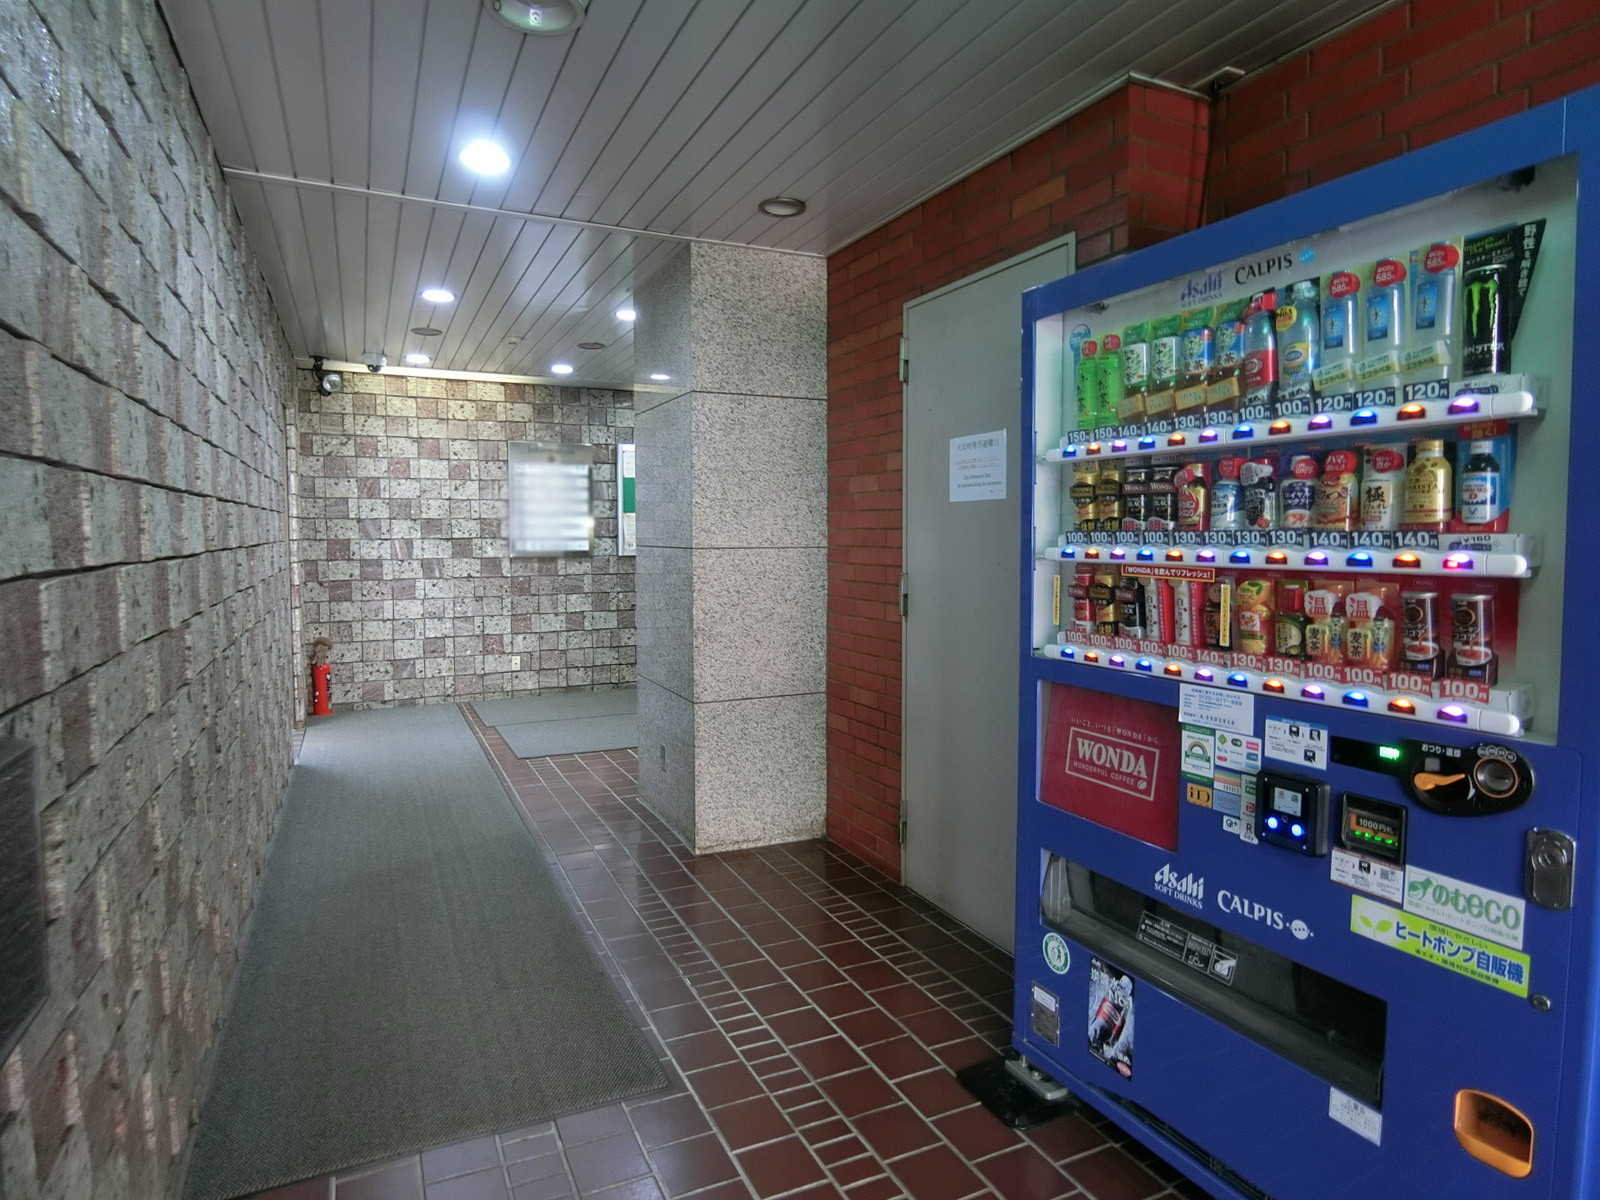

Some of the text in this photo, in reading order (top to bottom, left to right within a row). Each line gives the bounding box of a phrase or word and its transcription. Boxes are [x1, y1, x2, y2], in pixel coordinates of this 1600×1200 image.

[1235, 253, 1293, 285] CALPIS
[1181, 270, 1222, 301] Asahi
[1308, 596, 1329, 615] 温
[1350, 598, 1371, 618] 温
[1309, 627, 1321, 652] 麦茶
[1350, 631, 1362, 658] 麦茶
[1077, 737, 1147, 779] WONDA
[1073, 761, 1135, 785] WONDERFUL COFFEE
[1190, 787, 1210, 803] iD
[1155, 864, 1204, 900] Asahi
[1155, 882, 1203, 909] SOFT DRINKS
[1217, 890, 1283, 930] CALPIS
[1432, 885, 1521, 931] のむeco
[1396, 921, 1524, 985] ヒートポンプ自販機
